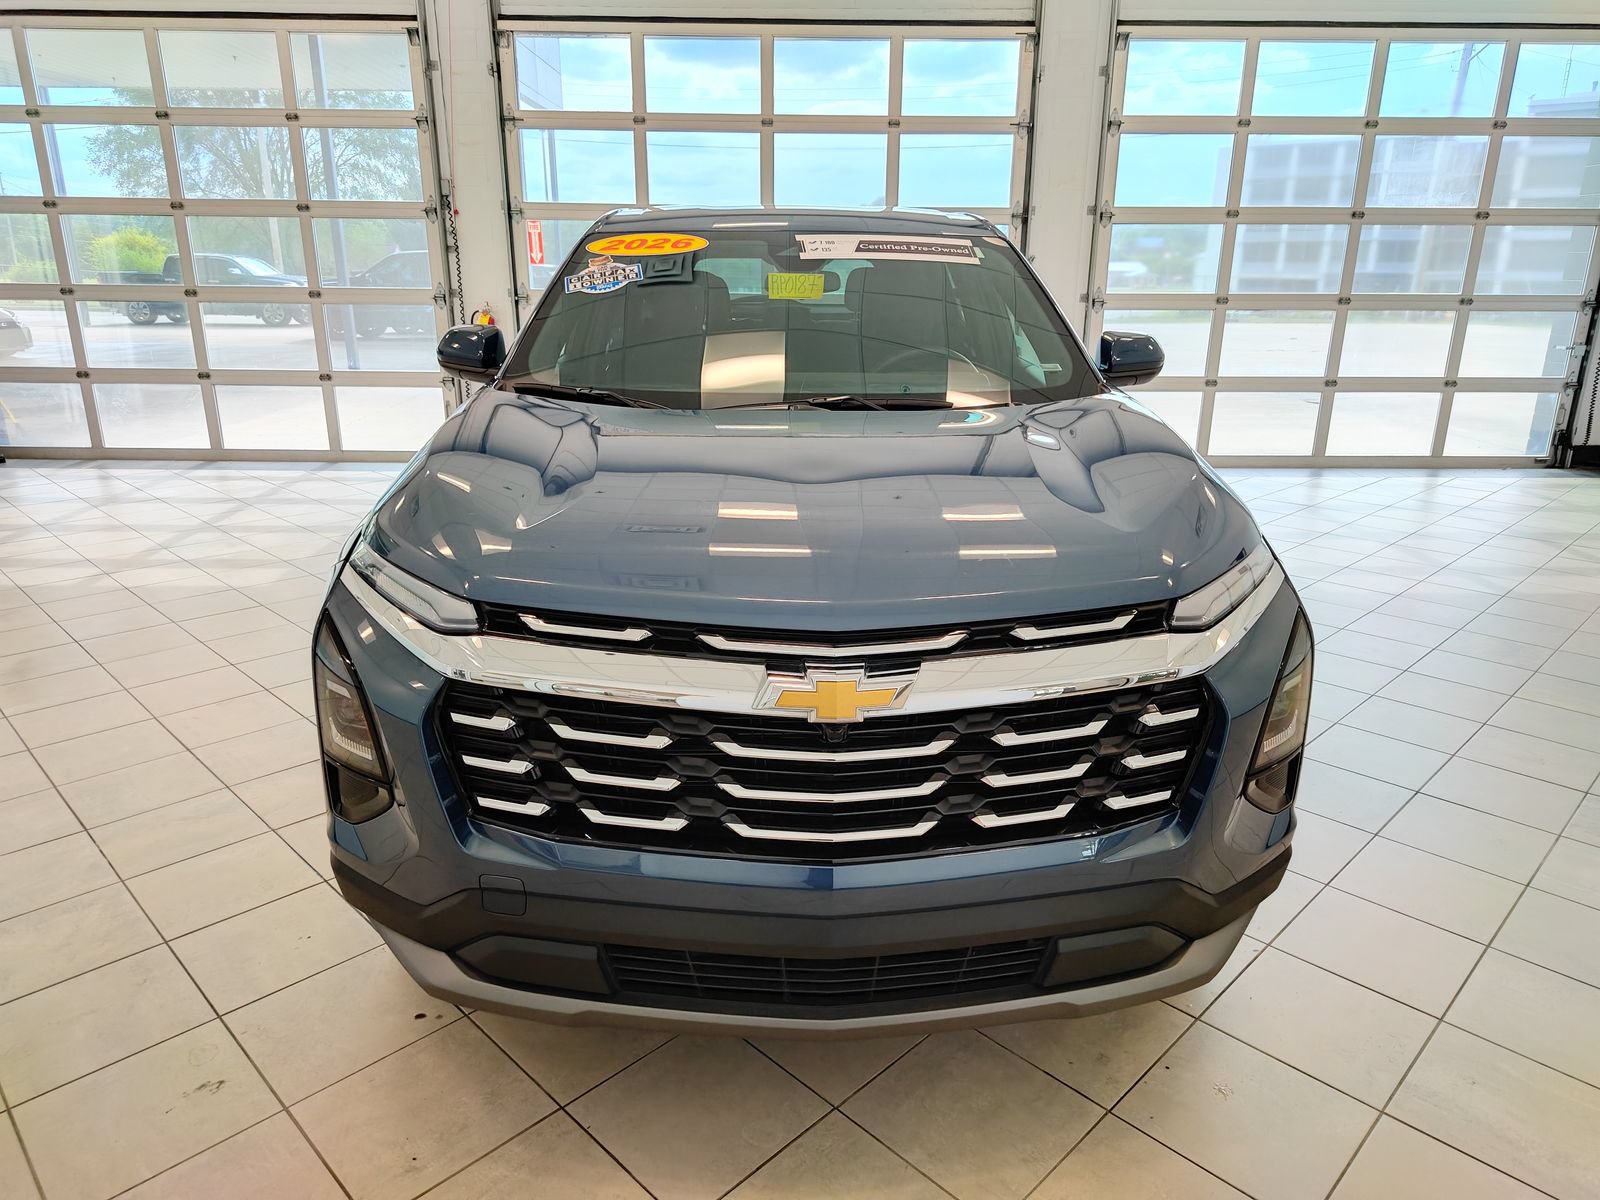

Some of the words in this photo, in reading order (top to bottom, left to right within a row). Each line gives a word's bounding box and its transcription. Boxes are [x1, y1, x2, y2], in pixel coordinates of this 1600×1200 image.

[599, 238, 696, 251] 2026
[859, 243, 908, 251] Certified
[910, 244, 969, 254] Pre-Owned
[570, 268, 637, 283] CARFAX
[582, 273, 637, 287] OWNER
